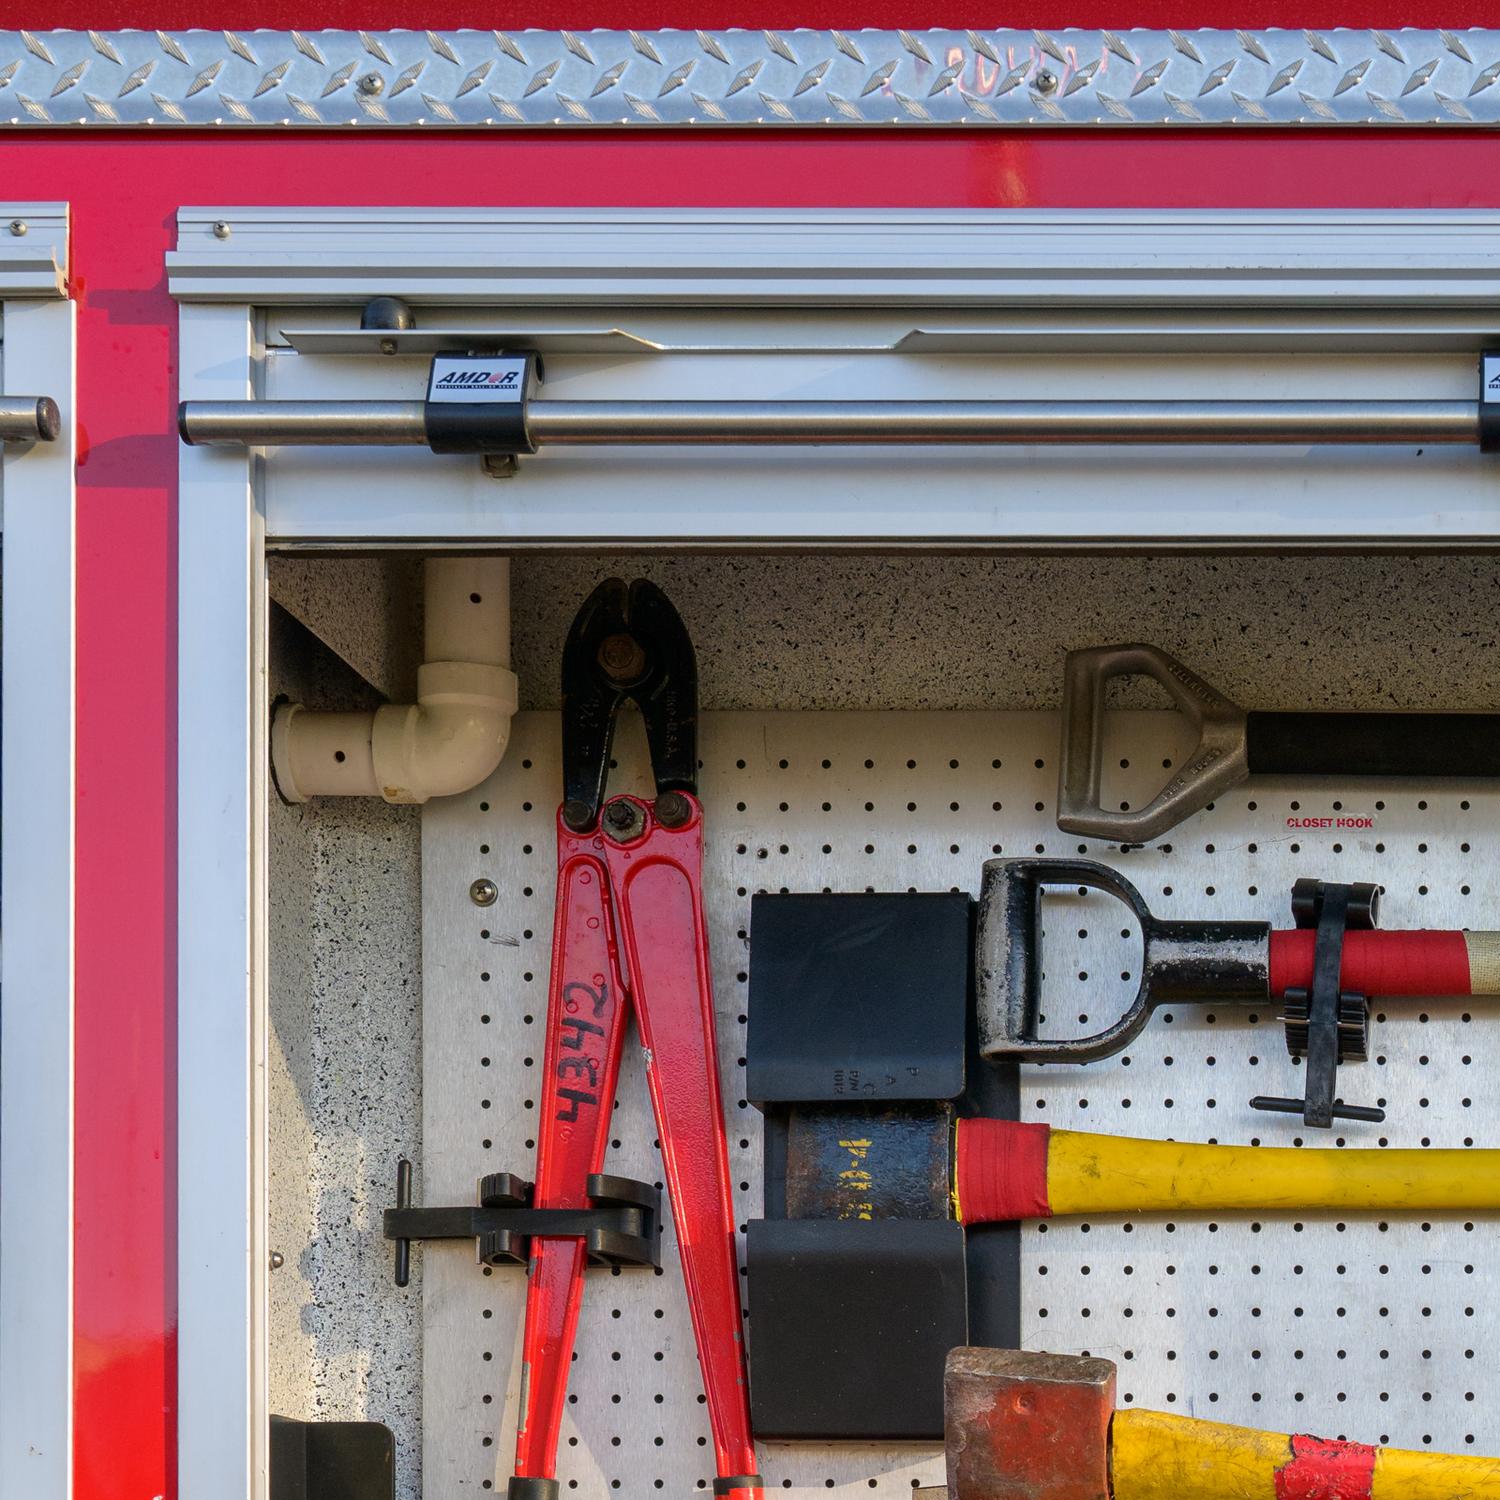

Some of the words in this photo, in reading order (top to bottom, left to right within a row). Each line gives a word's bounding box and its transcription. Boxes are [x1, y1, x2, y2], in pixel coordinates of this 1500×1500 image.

[1286, 817, 1334, 828] CLOSET
[1336, 817, 1373, 828] HOOK
[555, 982, 609, 1123] 4342
